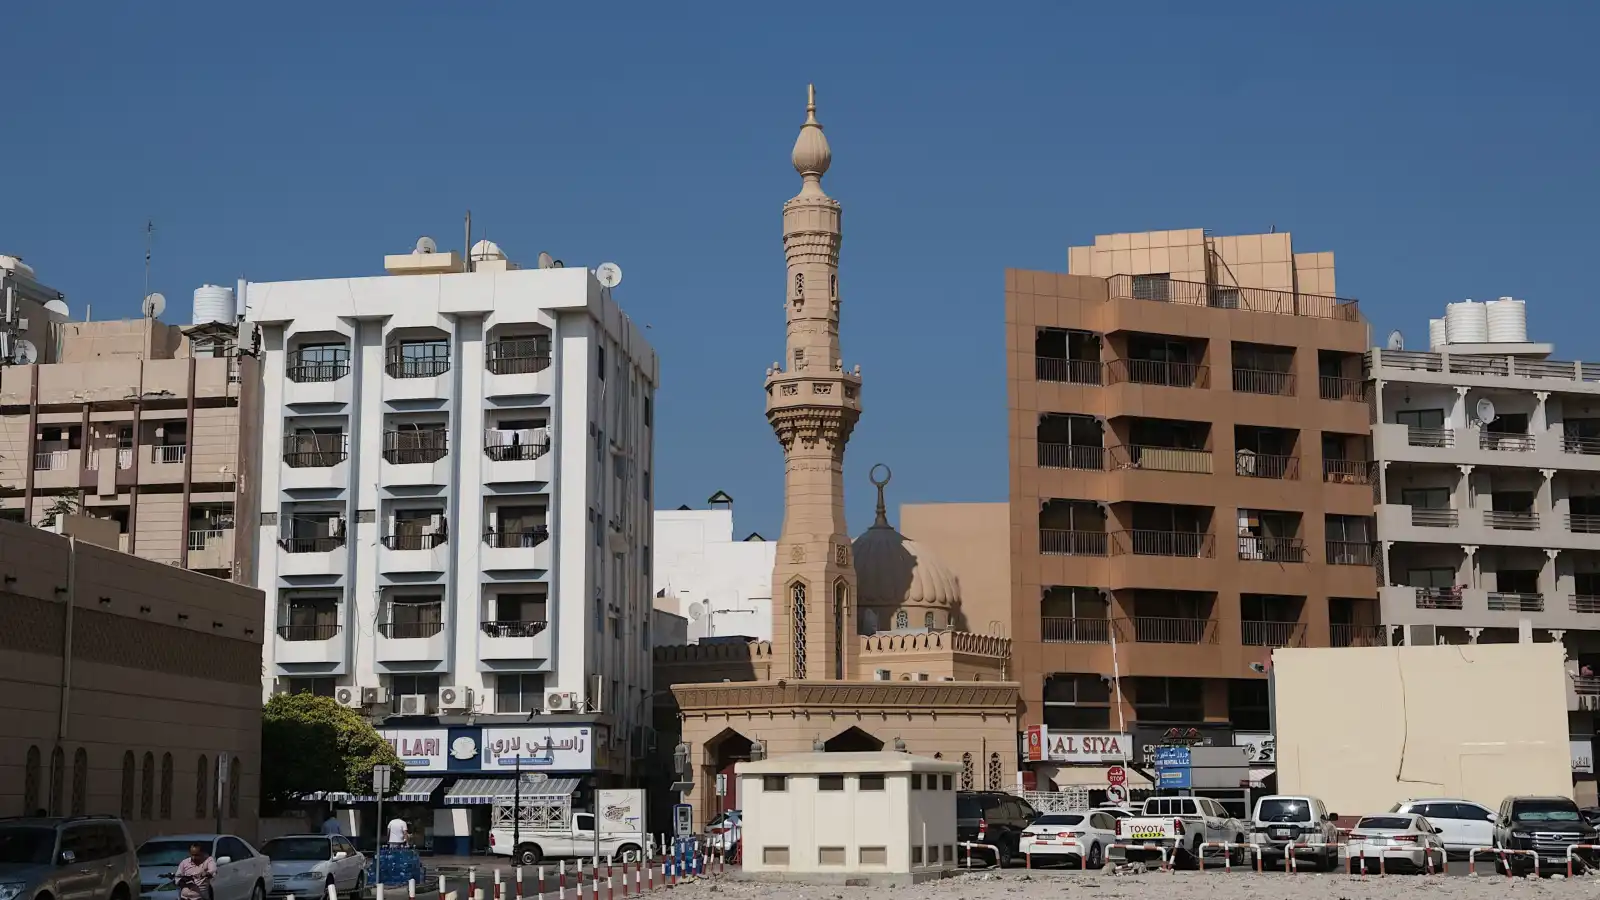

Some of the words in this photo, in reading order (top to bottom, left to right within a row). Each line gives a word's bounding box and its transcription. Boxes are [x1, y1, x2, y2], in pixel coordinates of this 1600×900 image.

[402, 738, 440, 756] LARI
[490, 736, 521, 757] لاري
[526, 736, 584, 757] راستي
[1053, 736, 1078, 754] AL
[1082, 736, 1121, 754] SIYA
[1129, 825, 1165, 833] TOYOTA
